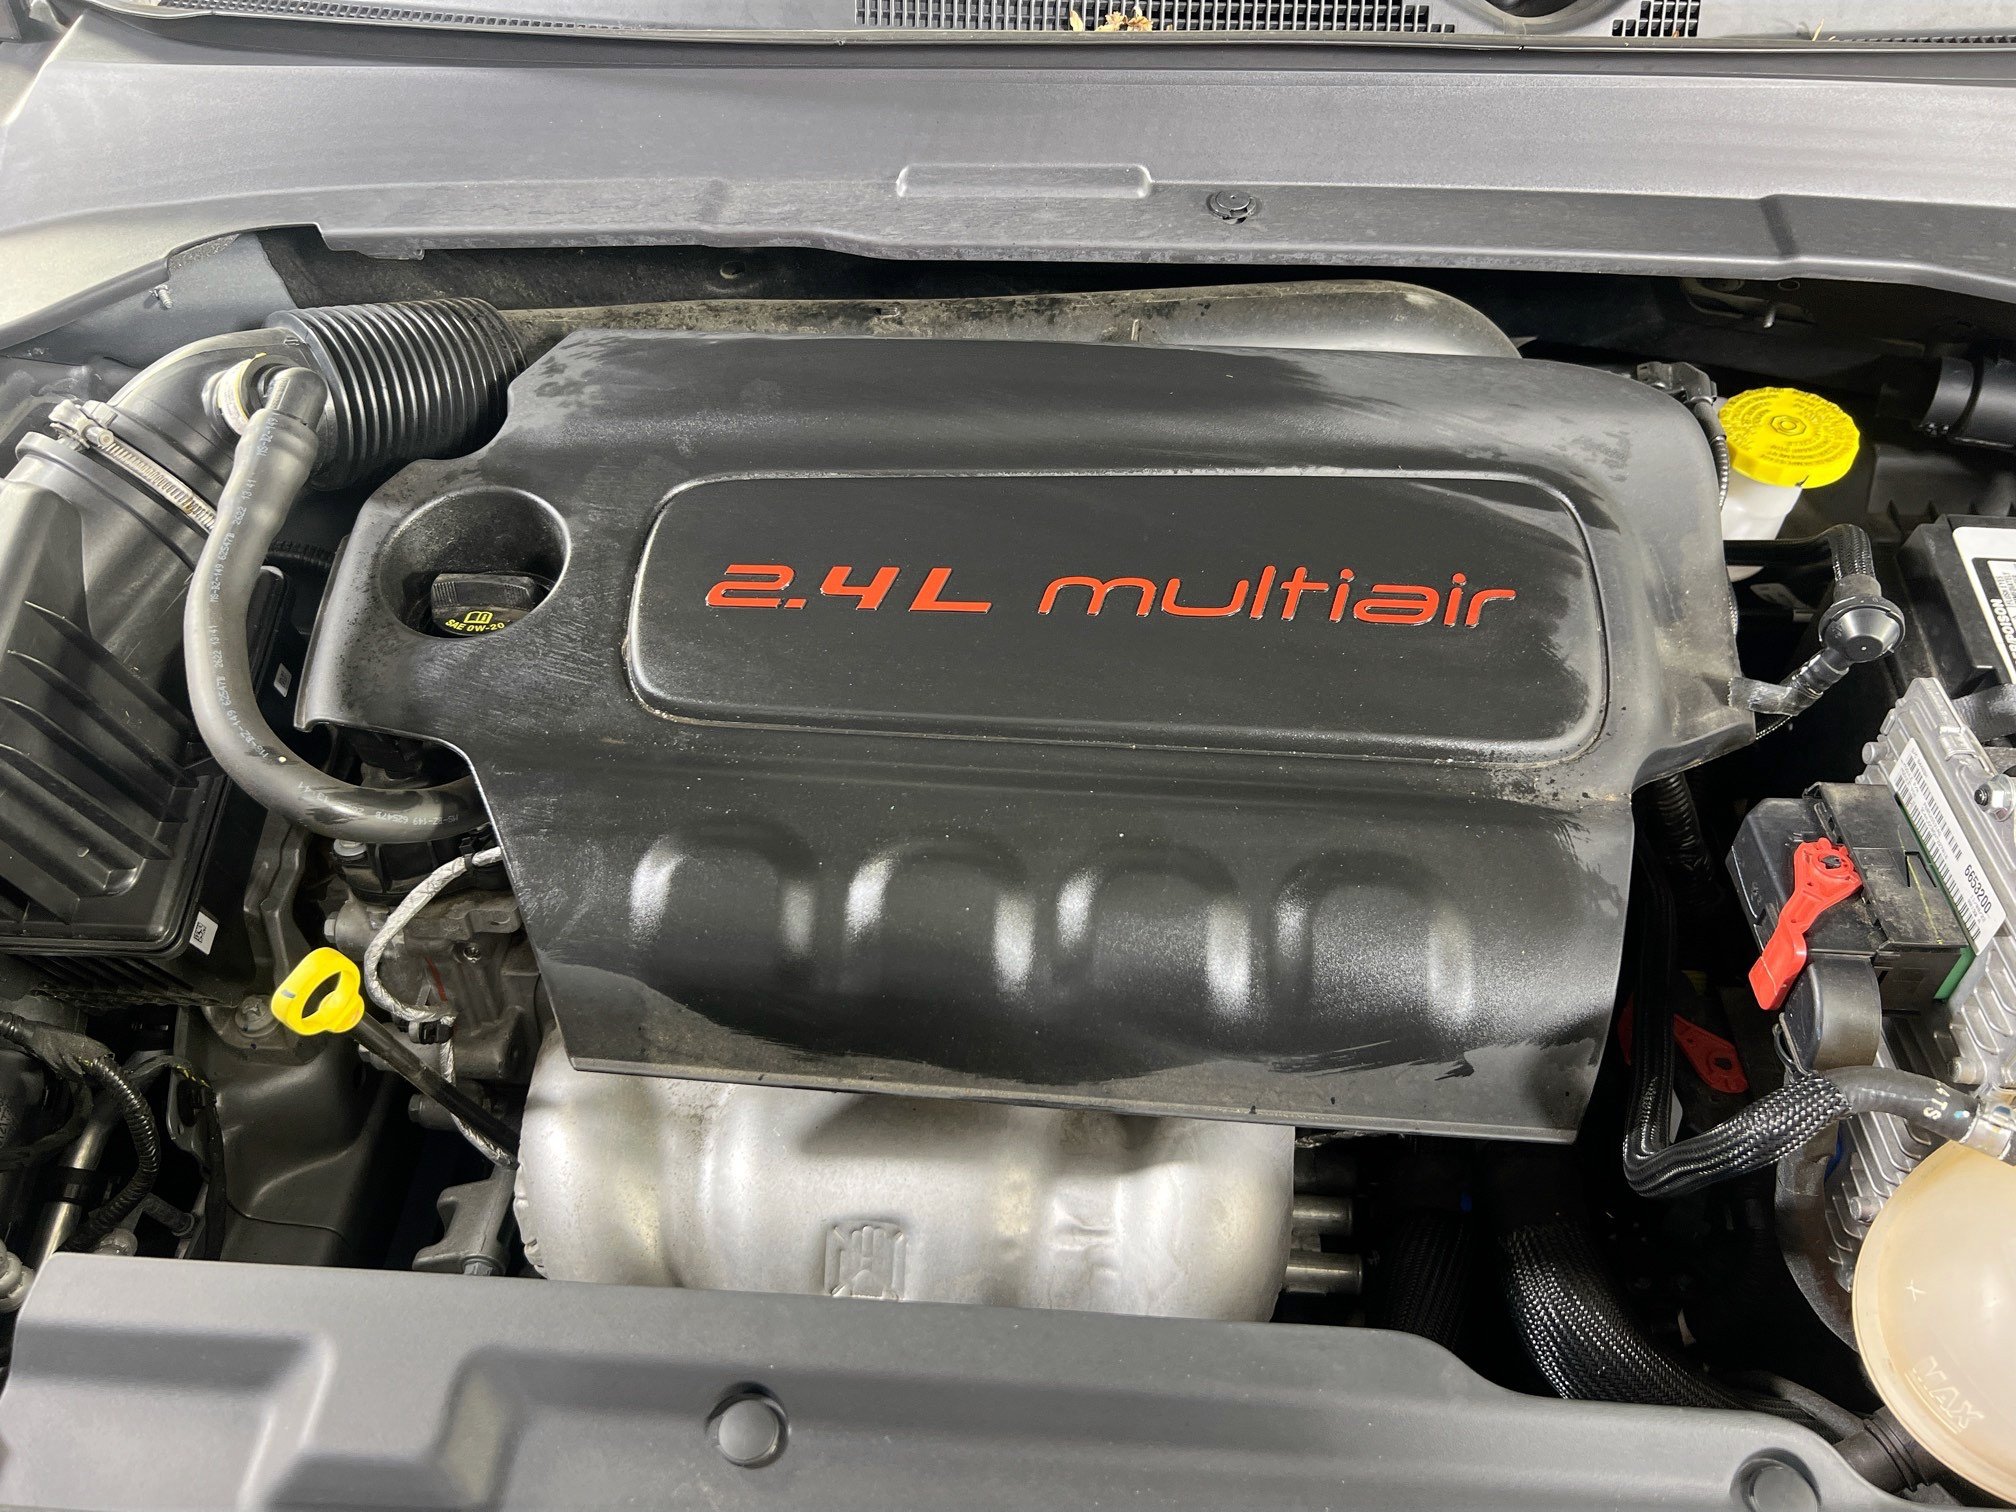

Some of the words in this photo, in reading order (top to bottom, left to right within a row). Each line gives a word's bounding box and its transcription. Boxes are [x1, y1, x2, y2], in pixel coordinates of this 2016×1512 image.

[704, 563, 992, 614] 2.4L
[1037, 564, 1517, 628] multiair
[445, 619, 466, 631] SAE
[466, 622, 505, 632] 0W-20
[209, 649, 225, 669] 2622
[1964, 864, 1992, 914] 6653200
[1912, 1355, 1985, 1430] MAX
